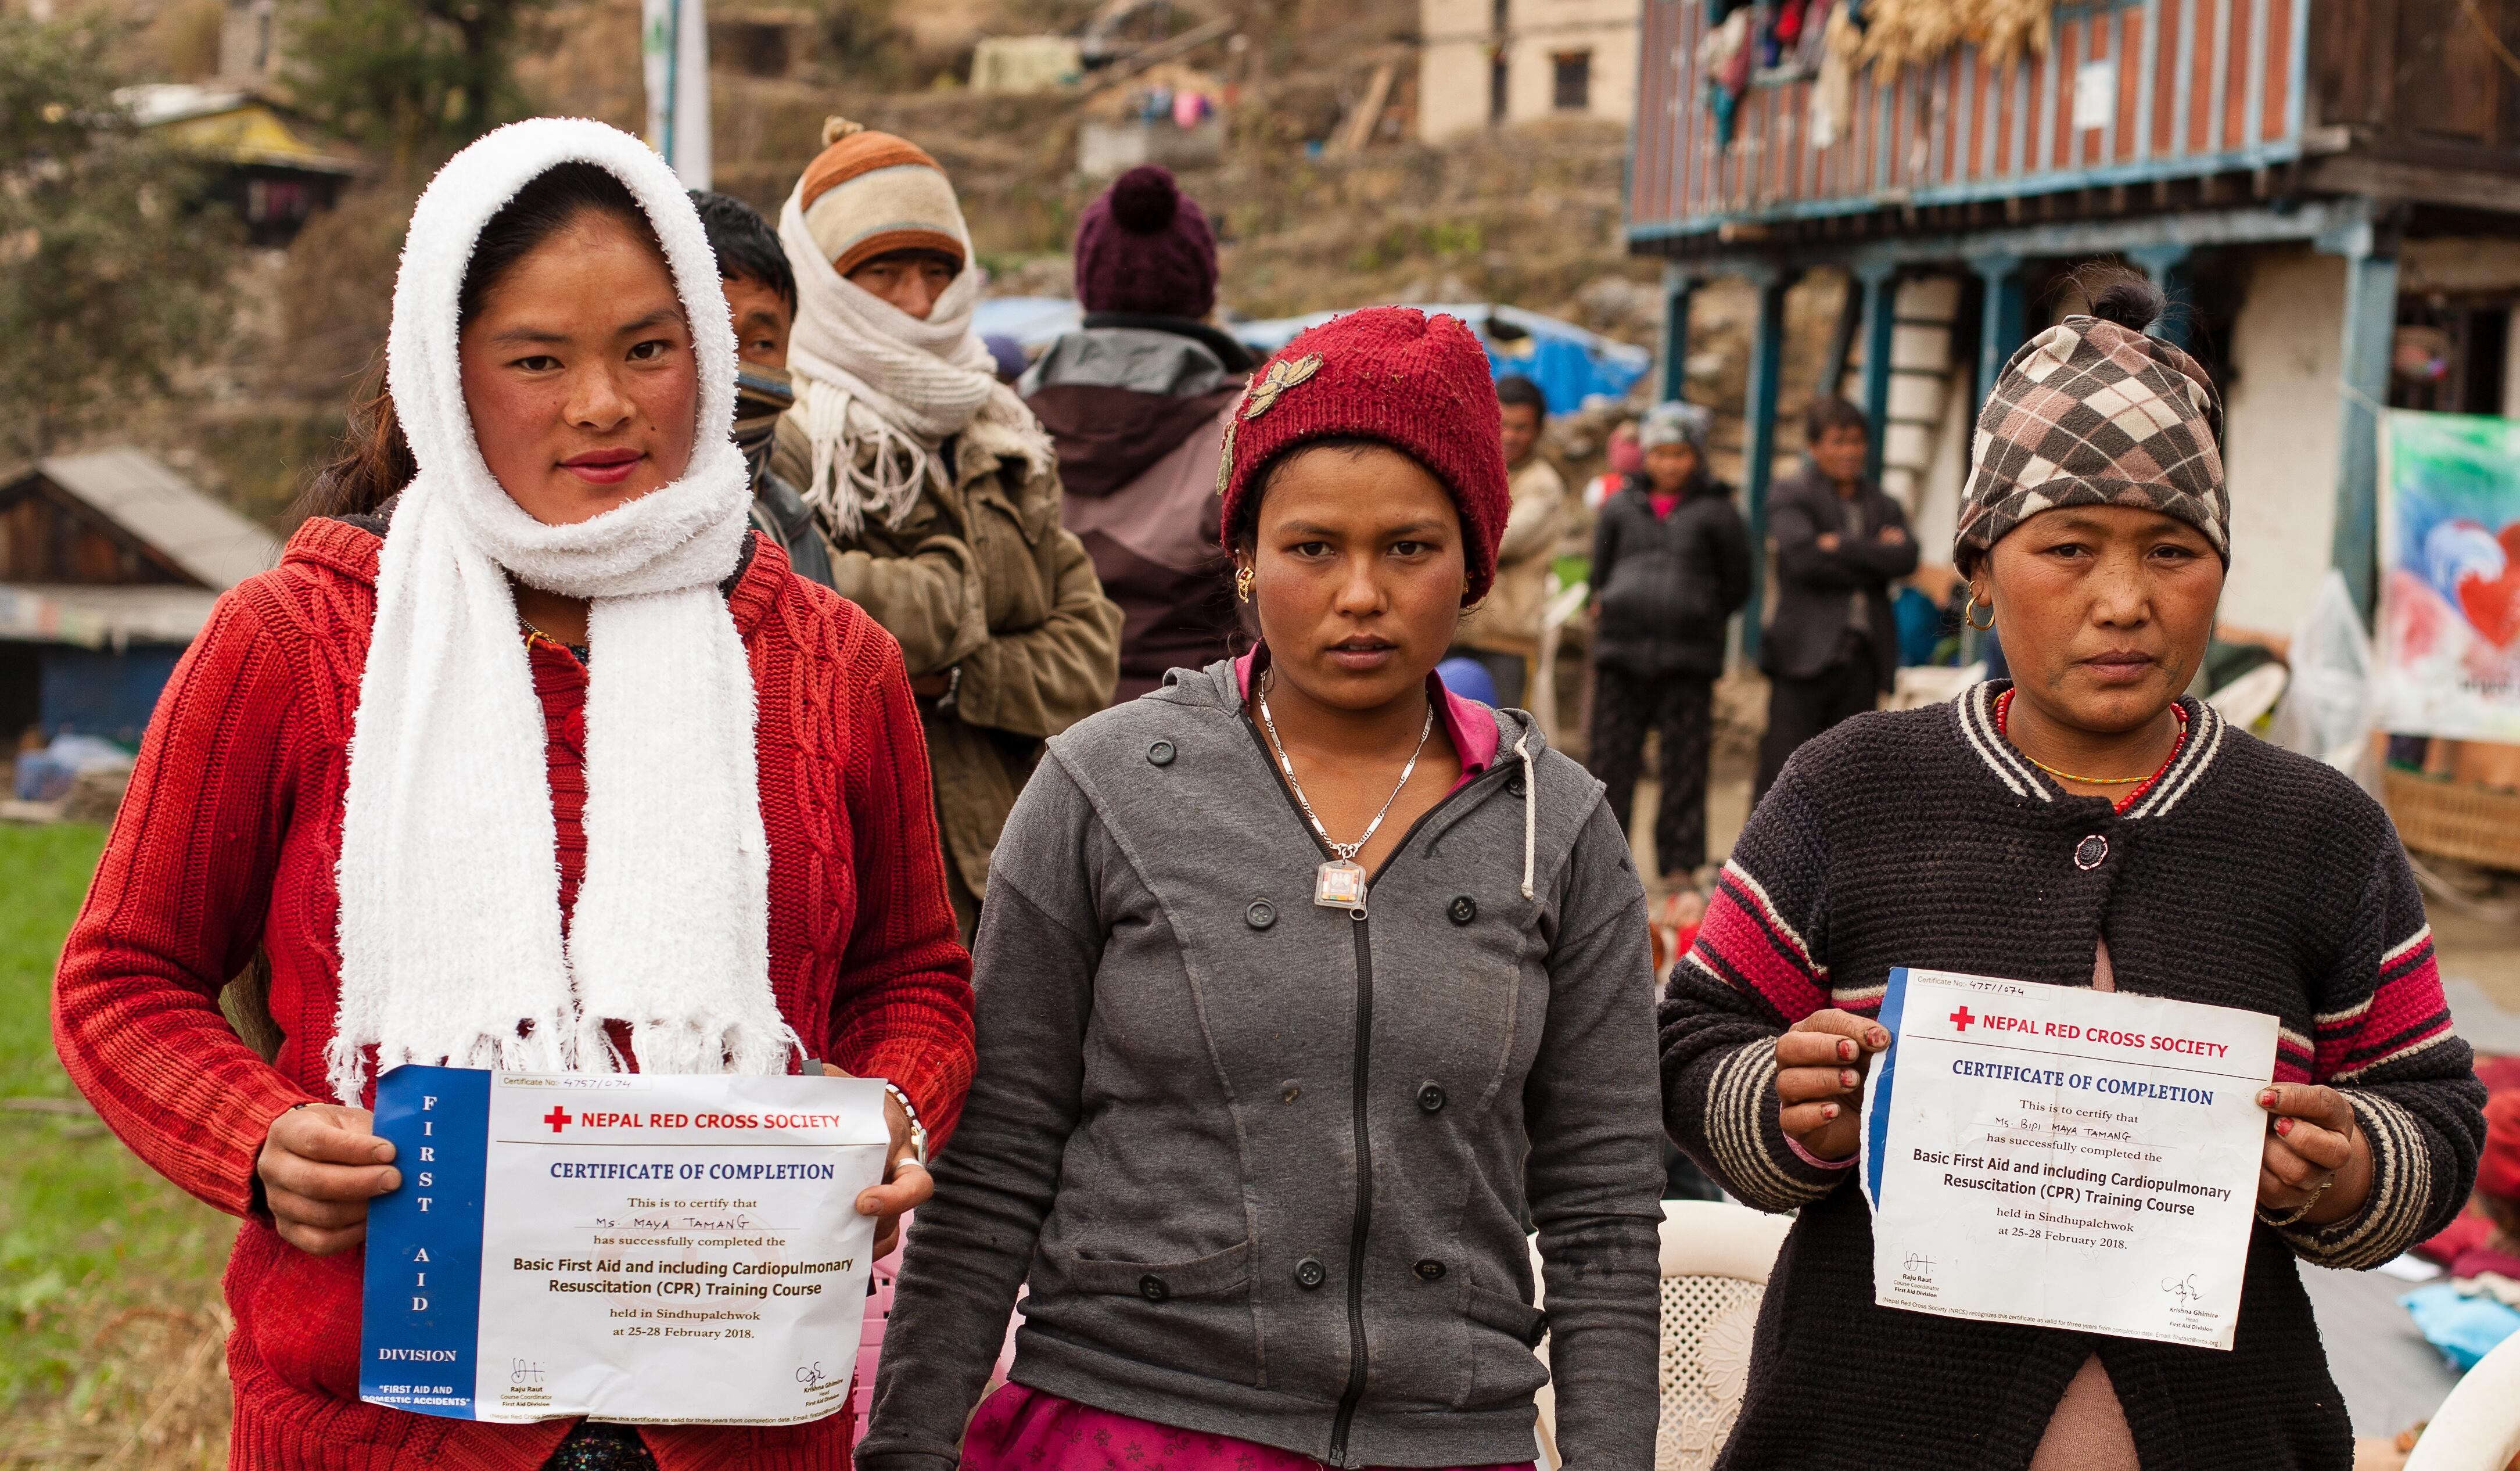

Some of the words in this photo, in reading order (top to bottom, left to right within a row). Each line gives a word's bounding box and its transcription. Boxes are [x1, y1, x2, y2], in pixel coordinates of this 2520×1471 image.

[1918, 976, 1951, 985] Certificate
[1983, 1014, 2038, 1035] NEPAL
[2045, 1022, 2080, 1039] RED
[2086, 1028, 2145, 1047] CROSS
[2150, 1036, 2228, 1058] SOCIETY
[504, 1077, 542, 1086] Certificate
[563, 1079, 631, 1088] 4757/074
[1952, 1060, 2064, 1086] CERTIFICATE
[2069, 1074, 2092, 1089] OF
[2097, 1078, 2214, 1105] COMPLETION
[2019, 1099, 2045, 1111] This
[2049, 1104, 2058, 1113] is
[2062, 1106, 2072, 1114] to
[2076, 1108, 2112, 1121] certify
[2116, 1113, 2138, 1123] that
[582, 1113, 642, 1127] NEPAL
[650, 1114, 688, 1128] RED
[695, 1114, 758, 1128] CROSS
[764, 1115, 840, 1128] SOCIETY
[2052, 1124, 2077, 1135] MAYA
[2084, 1128, 2131, 1142] TAMANG
[417, 1096, 437, 1212] FIRST
[1987, 1133, 2005, 1143] has
[2009, 1136, 2077, 1153] successfully
[2080, 1146, 2141, 1160] completed
[2145, 1153, 2162, 1162] the
[551, 1163, 673, 1179] CERTIFICATE
[680, 1164, 705, 1179] OF
[710, 1164, 834, 1179] COMPLETION
[1914, 1149, 1949, 1164] Basic
[1954, 1154, 1984, 1168] First
[1987, 1158, 2010, 1171] Aid
[2014, 1163, 2039, 1174] and
[2043, 1163, 2106, 1186] including
[2112, 1173, 2231, 1201] Cardiopulmonary
[1944, 1174, 2036, 1195] Resuscitation
[2040, 1184, 2080, 1203] (CPR)
[2085, 1190, 2142, 1211] Training
[2147, 1198, 2195, 1215] Course
[627, 1198, 655, 1208] This
[660, 1199, 669, 1208] is
[674, 1200, 685, 1208] to
[690, 1198, 729, 1210] certify
[734, 1199, 756, 1208] that
[634, 1218, 669, 1230] MAYA
[683, 1214, 749, 1229] TAMANG
[1997, 1207, 2020, 1218] held
[2024, 1211, 2034, 1219] in
[2038, 1211, 2134, 1232] Sindhupalchwok
[594, 1236, 615, 1244] has
[619, 1237, 693, 1248] successfully
[698, 1237, 762, 1248] completed
[767, 1237, 785, 1246] the
[2012, 1227, 2041, 1239] 25-28
[2045, 1230, 2097, 1248] February
[2100, 1238, 2127, 1249] 2018.
[514, 1258, 553, 1271] Basic
[558, 1259, 592, 1271] First
[597, 1260, 620, 1272] Aid
[626, 1261, 653, 1272] and
[658, 1261, 727, 1278] including
[733, 1258, 853, 1277] Cardiopulmonary
[412, 1248, 430, 1311] AID
[1911, 1283, 1940, 1291] Coordinator
[550, 1279, 651, 1293] Resuscitation
[657, 1281, 701, 1297] (CPR)
[706, 1283, 767, 1299] Training
[773, 1284, 821, 1296] Course
[609, 1309, 636, 1318] held
[641, 1309, 652, 1318] in
[657, 1310, 761, 1321] Sindhupalchwok
[1929, 1304, 1947, 1313] Society
[2170, 1307, 2192, 1315] Krishna
[2194, 1310, 2219, 1318] Ghimire
[629, 1328, 660, 1336] 25-28
[665, 1328, 720, 1340] February
[725, 1329, 754, 1338] 2018.
[379, 1348, 457, 1361] DIVISION
[379, 1385, 411, 1394] "FIRST
[804, 1385, 824, 1393] Krishna
[825, 1379, 843, 1389] Ghimire
